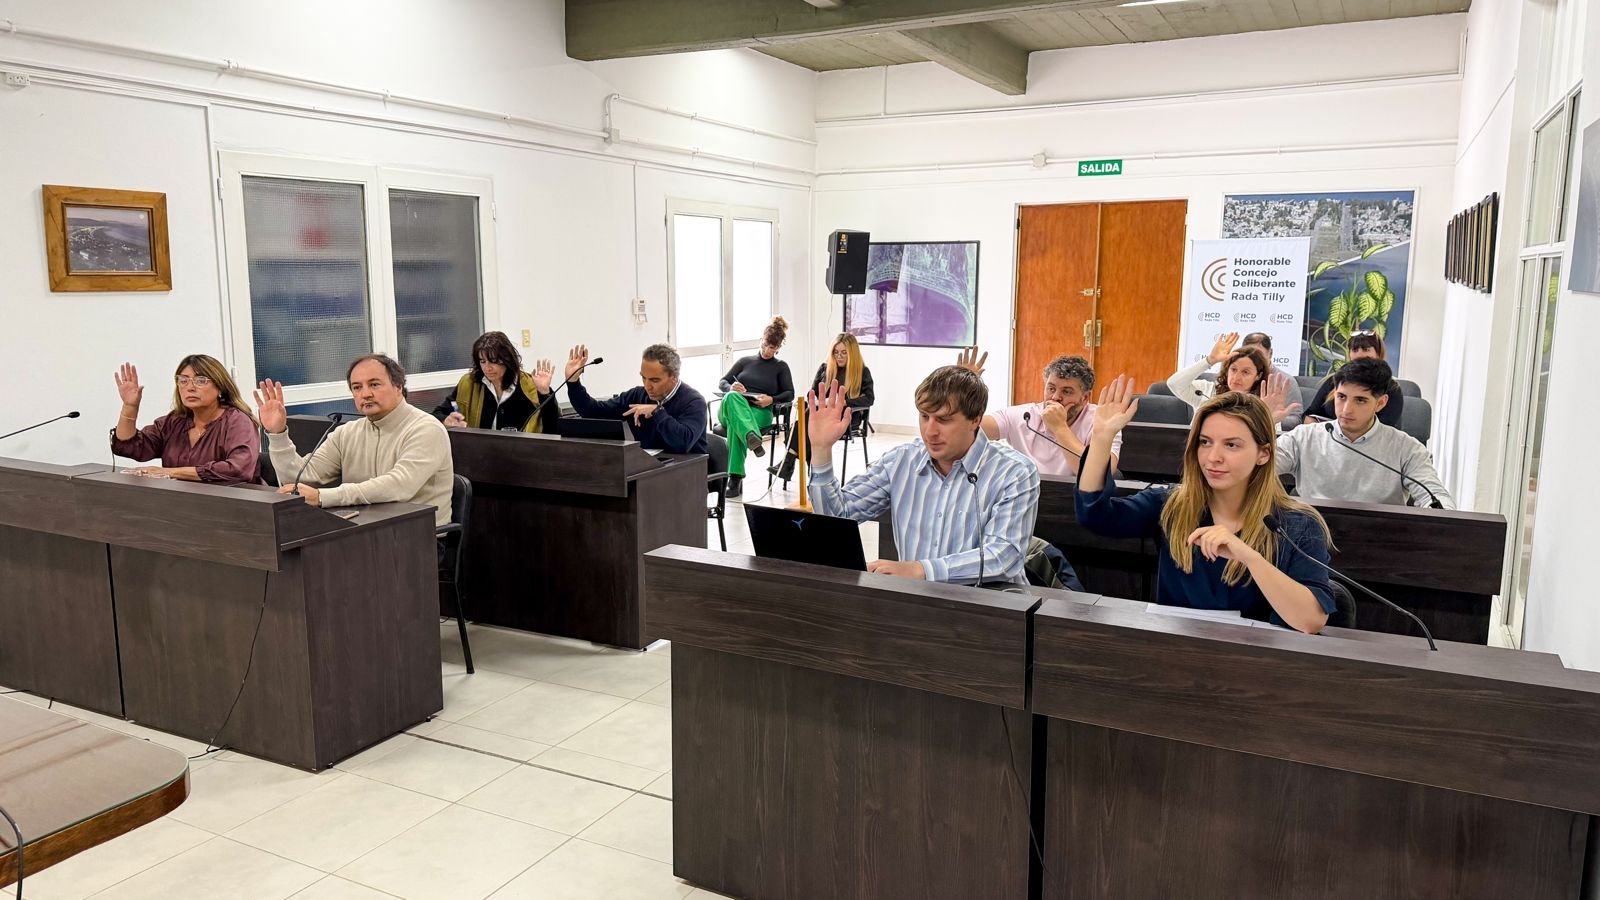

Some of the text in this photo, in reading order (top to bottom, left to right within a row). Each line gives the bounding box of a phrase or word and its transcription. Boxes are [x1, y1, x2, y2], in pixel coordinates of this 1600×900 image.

[1080, 162, 1120, 174] SALIDA
[1234, 257, 1291, 266] Honorable
[1233, 268, 1278, 278] Concejo
[1232, 279, 1296, 288] Deliberante
[1231, 292, 1285, 303] Rada Tilly
